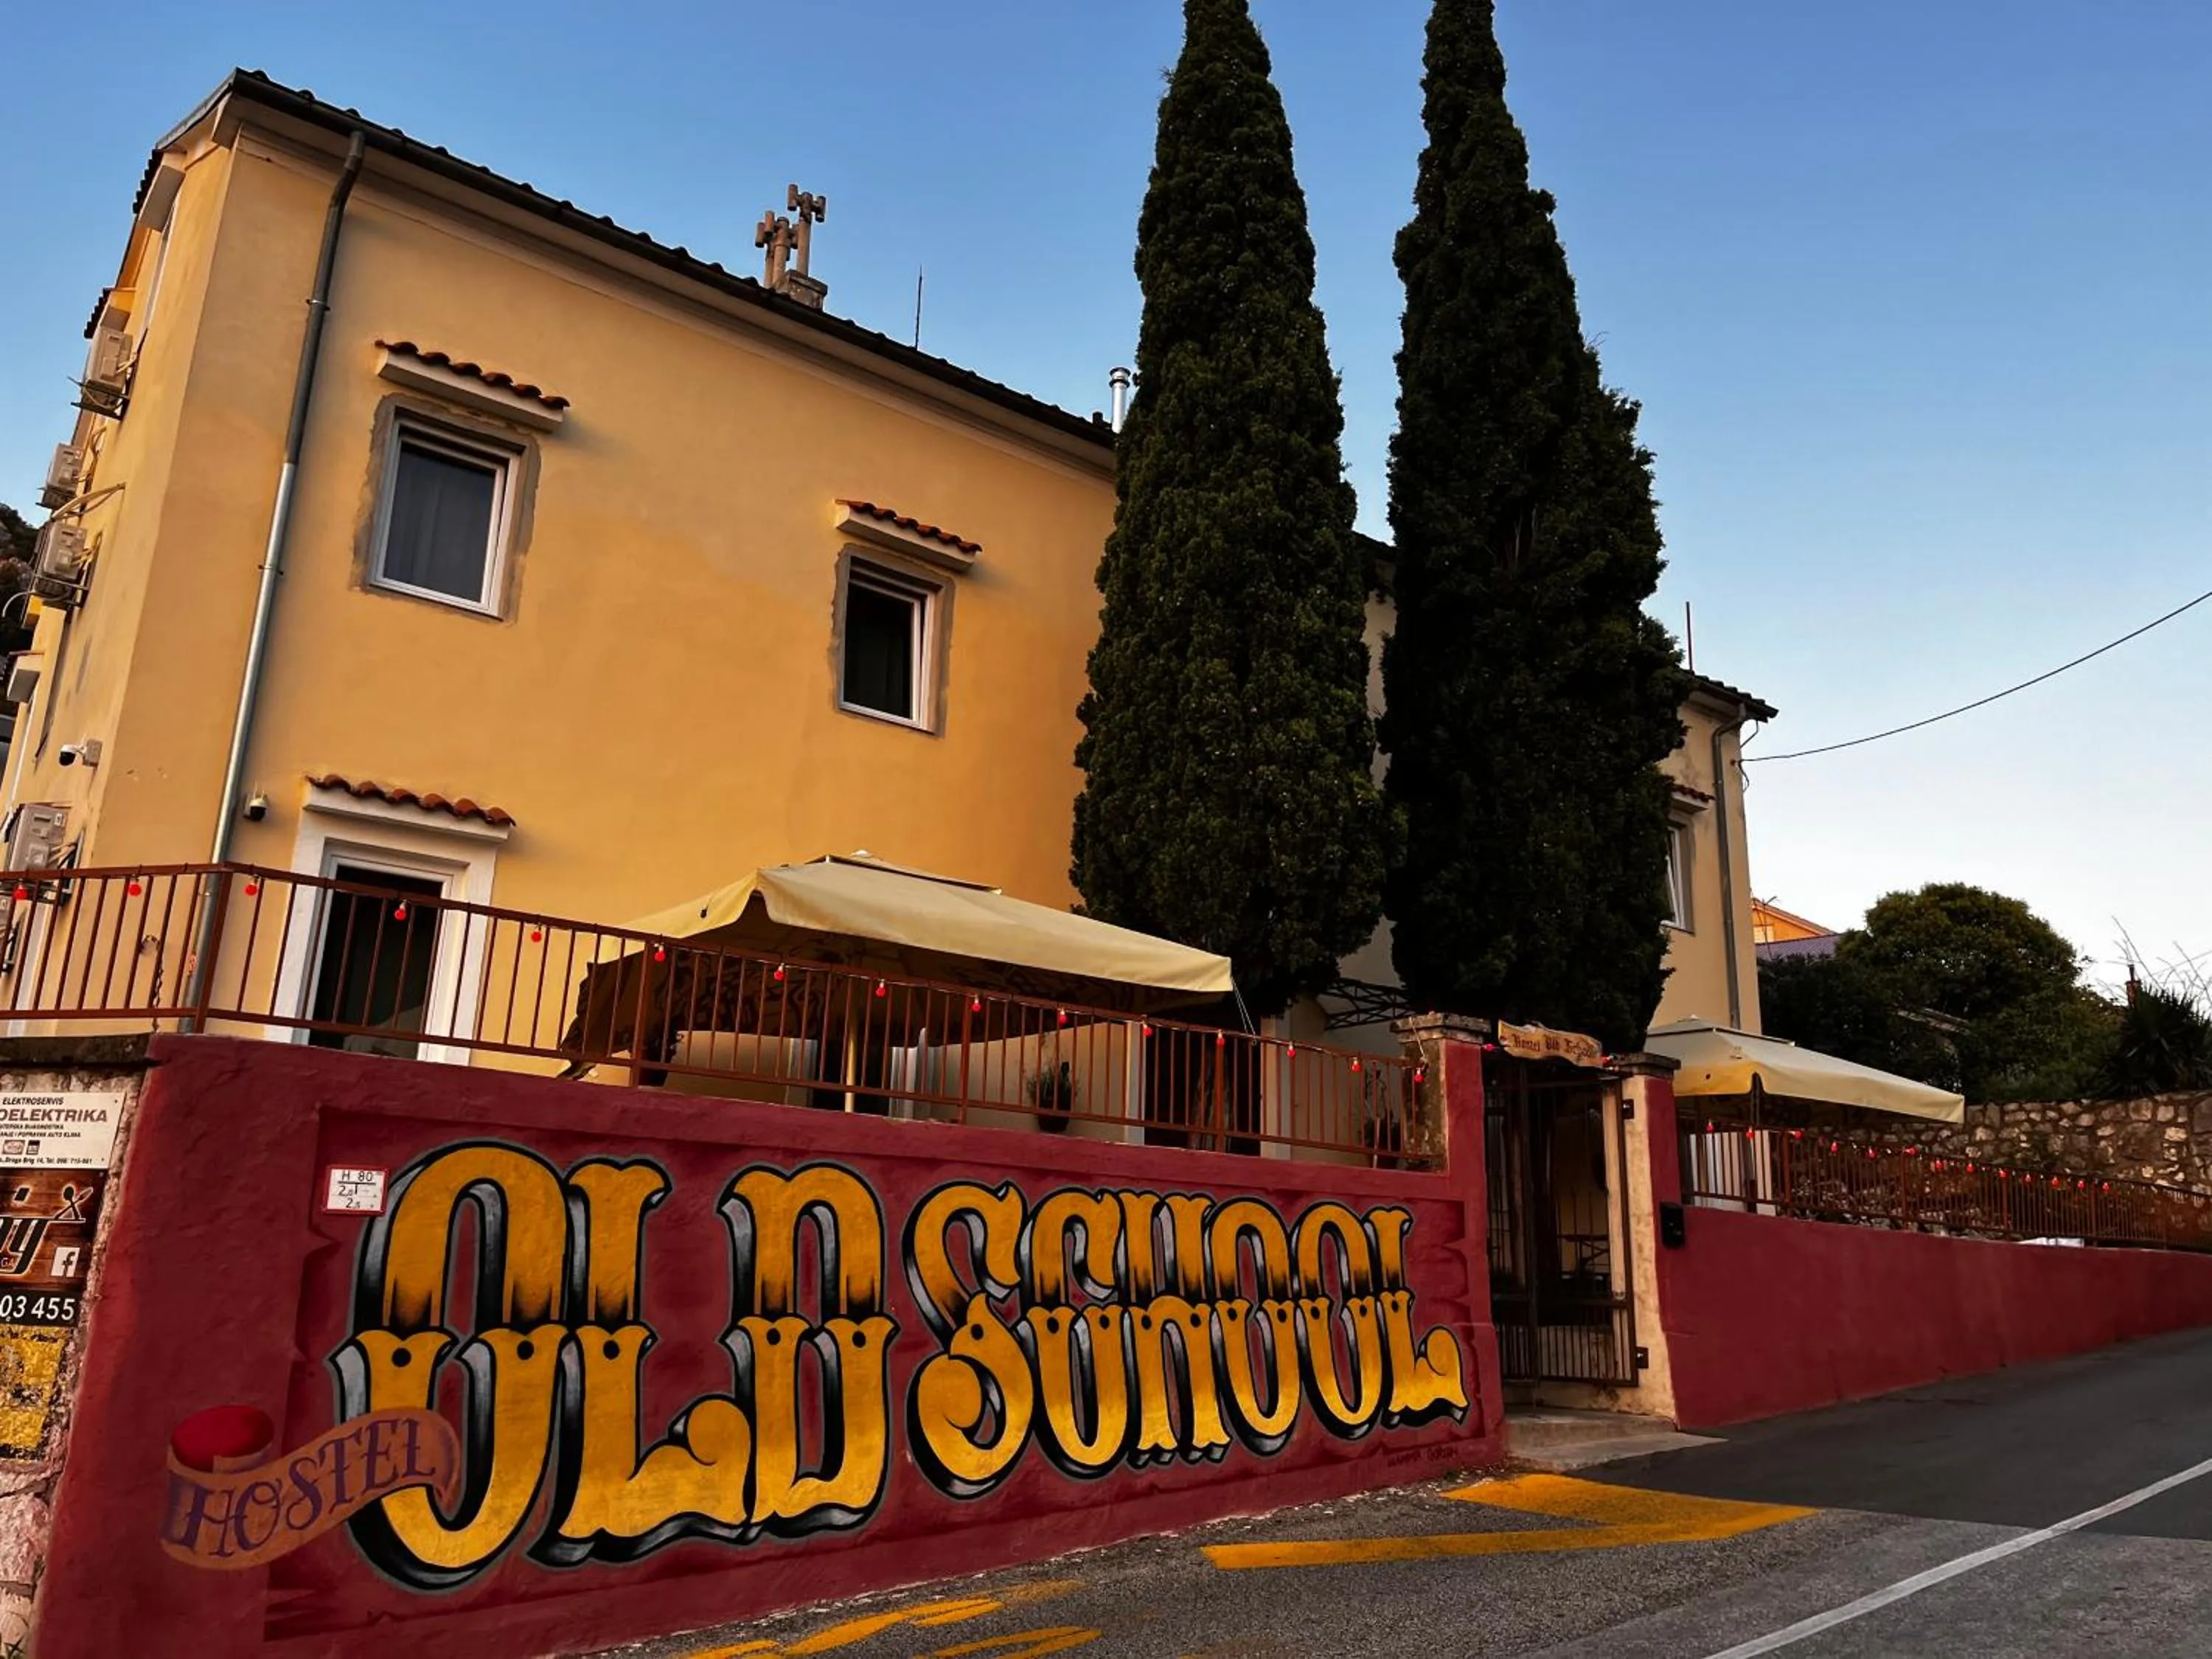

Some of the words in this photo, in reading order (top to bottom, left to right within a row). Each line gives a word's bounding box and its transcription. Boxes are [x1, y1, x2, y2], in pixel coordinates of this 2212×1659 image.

[2, 1097, 64, 1105] ELEKTROSERVIS
[341, 1170, 350, 1180] H
[358, 1170, 373, 1182] 80
[0, 1295, 27, 1318] 03
[31, 1297, 75, 1321] 455
[327, 1140, 901, 1594] OLD
[903, 1180, 1470, 1501] SCHOOL
[171, 1417, 436, 1557] HOSTEL
